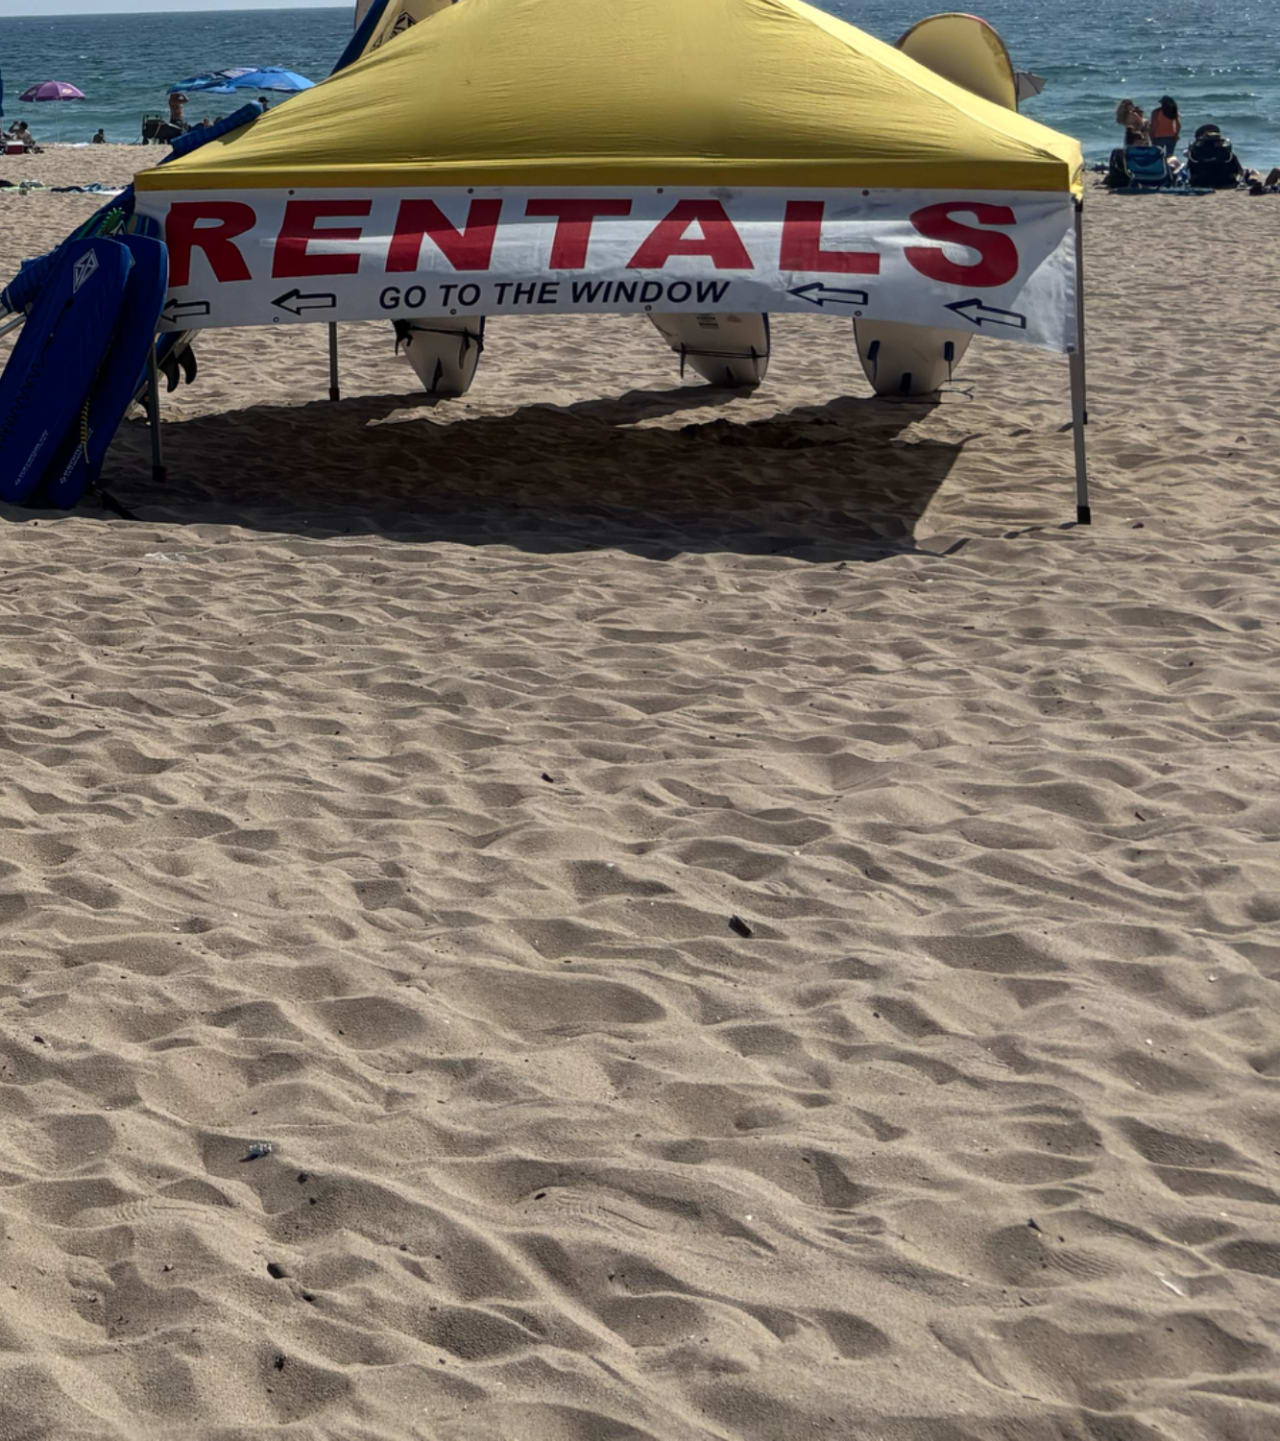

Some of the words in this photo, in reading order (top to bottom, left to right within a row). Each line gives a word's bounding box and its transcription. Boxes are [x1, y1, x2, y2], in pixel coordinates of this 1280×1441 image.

[165, 198, 1019, 288] RENTALS
[379, 285, 426, 309] GO
[440, 283, 481, 307] TO
[494, 281, 560, 305] THE
[571, 280, 731, 305] WINDOW
